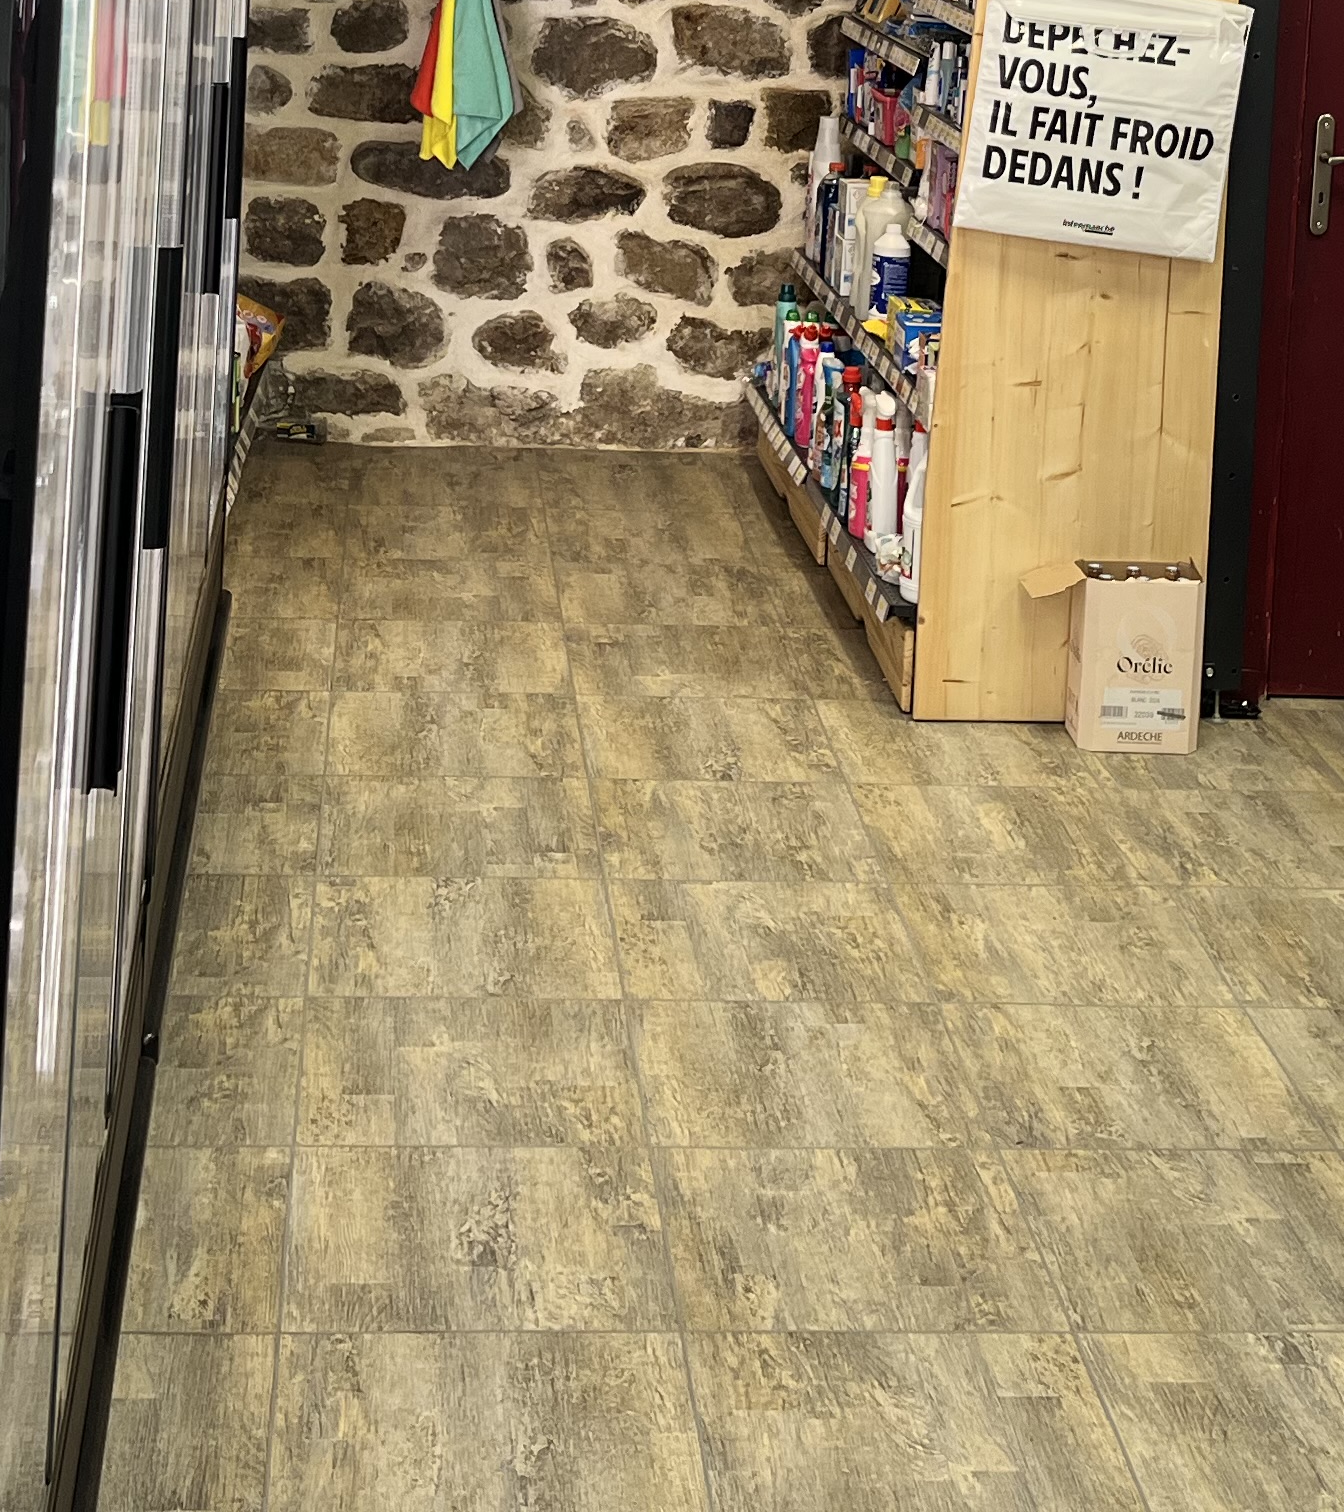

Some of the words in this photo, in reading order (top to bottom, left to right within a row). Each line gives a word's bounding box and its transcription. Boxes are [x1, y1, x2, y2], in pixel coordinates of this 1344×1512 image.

[998, 54, 1098, 108] VOUS,
[989, 100, 1017, 137] IL
[1029, 106, 1104, 148] FAIT
[1110, 117, 1215, 161] FROID
[982, 145, 1124, 197] DEDANS
[1117, 731, 1164, 742] ARDECHE
